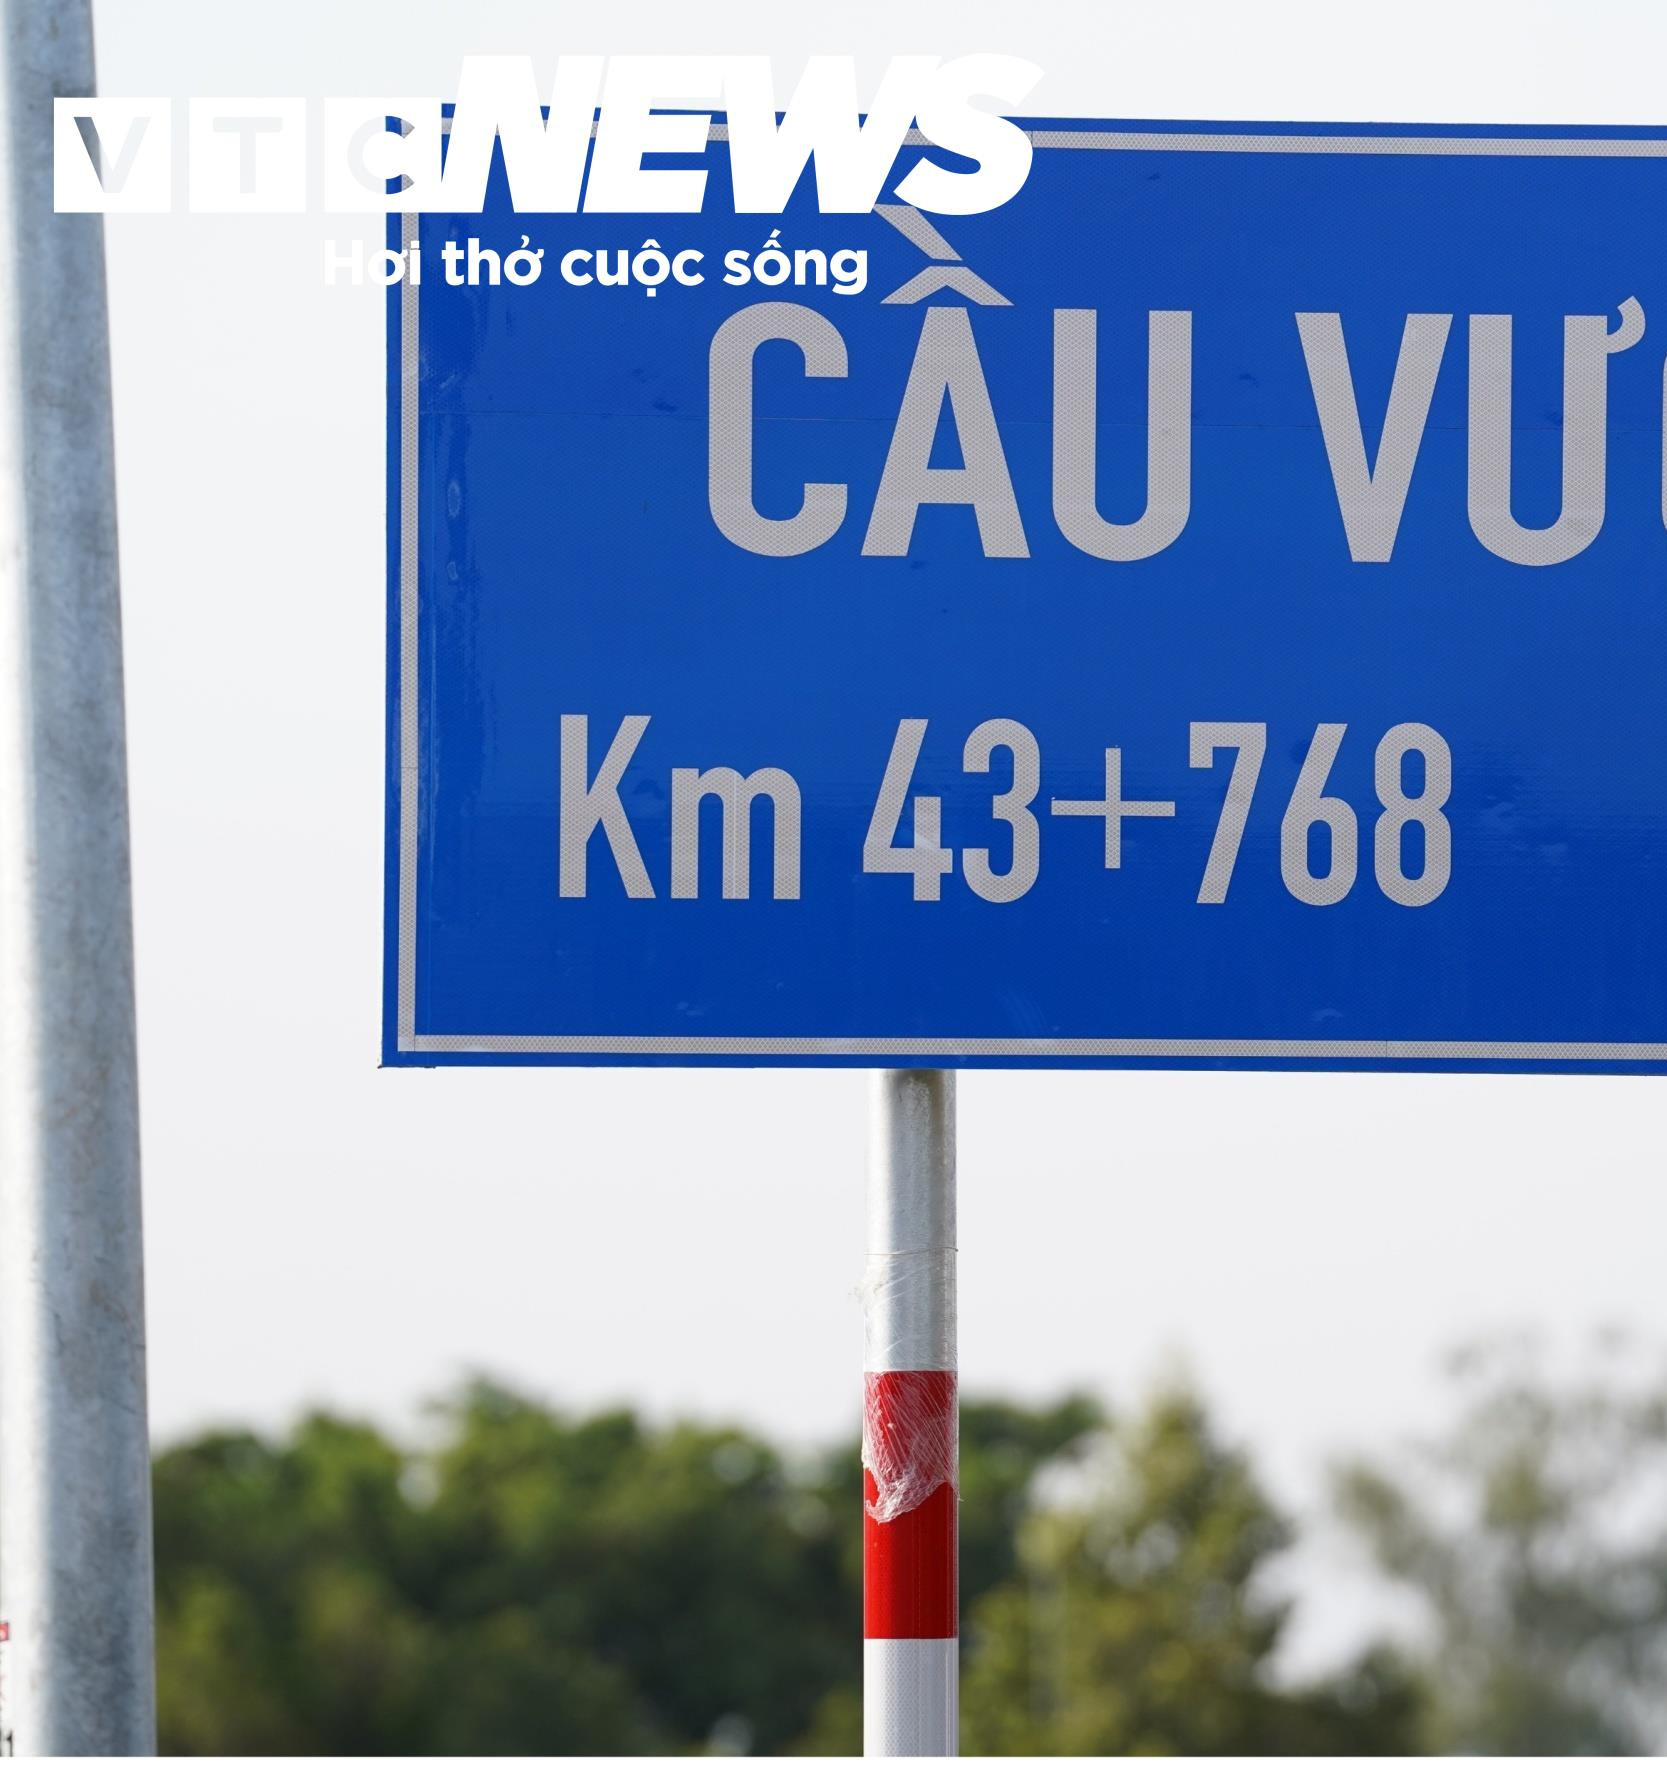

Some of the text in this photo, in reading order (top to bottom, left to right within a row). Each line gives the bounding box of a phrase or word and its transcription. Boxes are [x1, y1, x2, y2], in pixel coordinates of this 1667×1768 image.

[709, 204, 1192, 561] CẦU
[560, 715, 801, 899] Km
[864, 719, 1451, 906] 43+768
